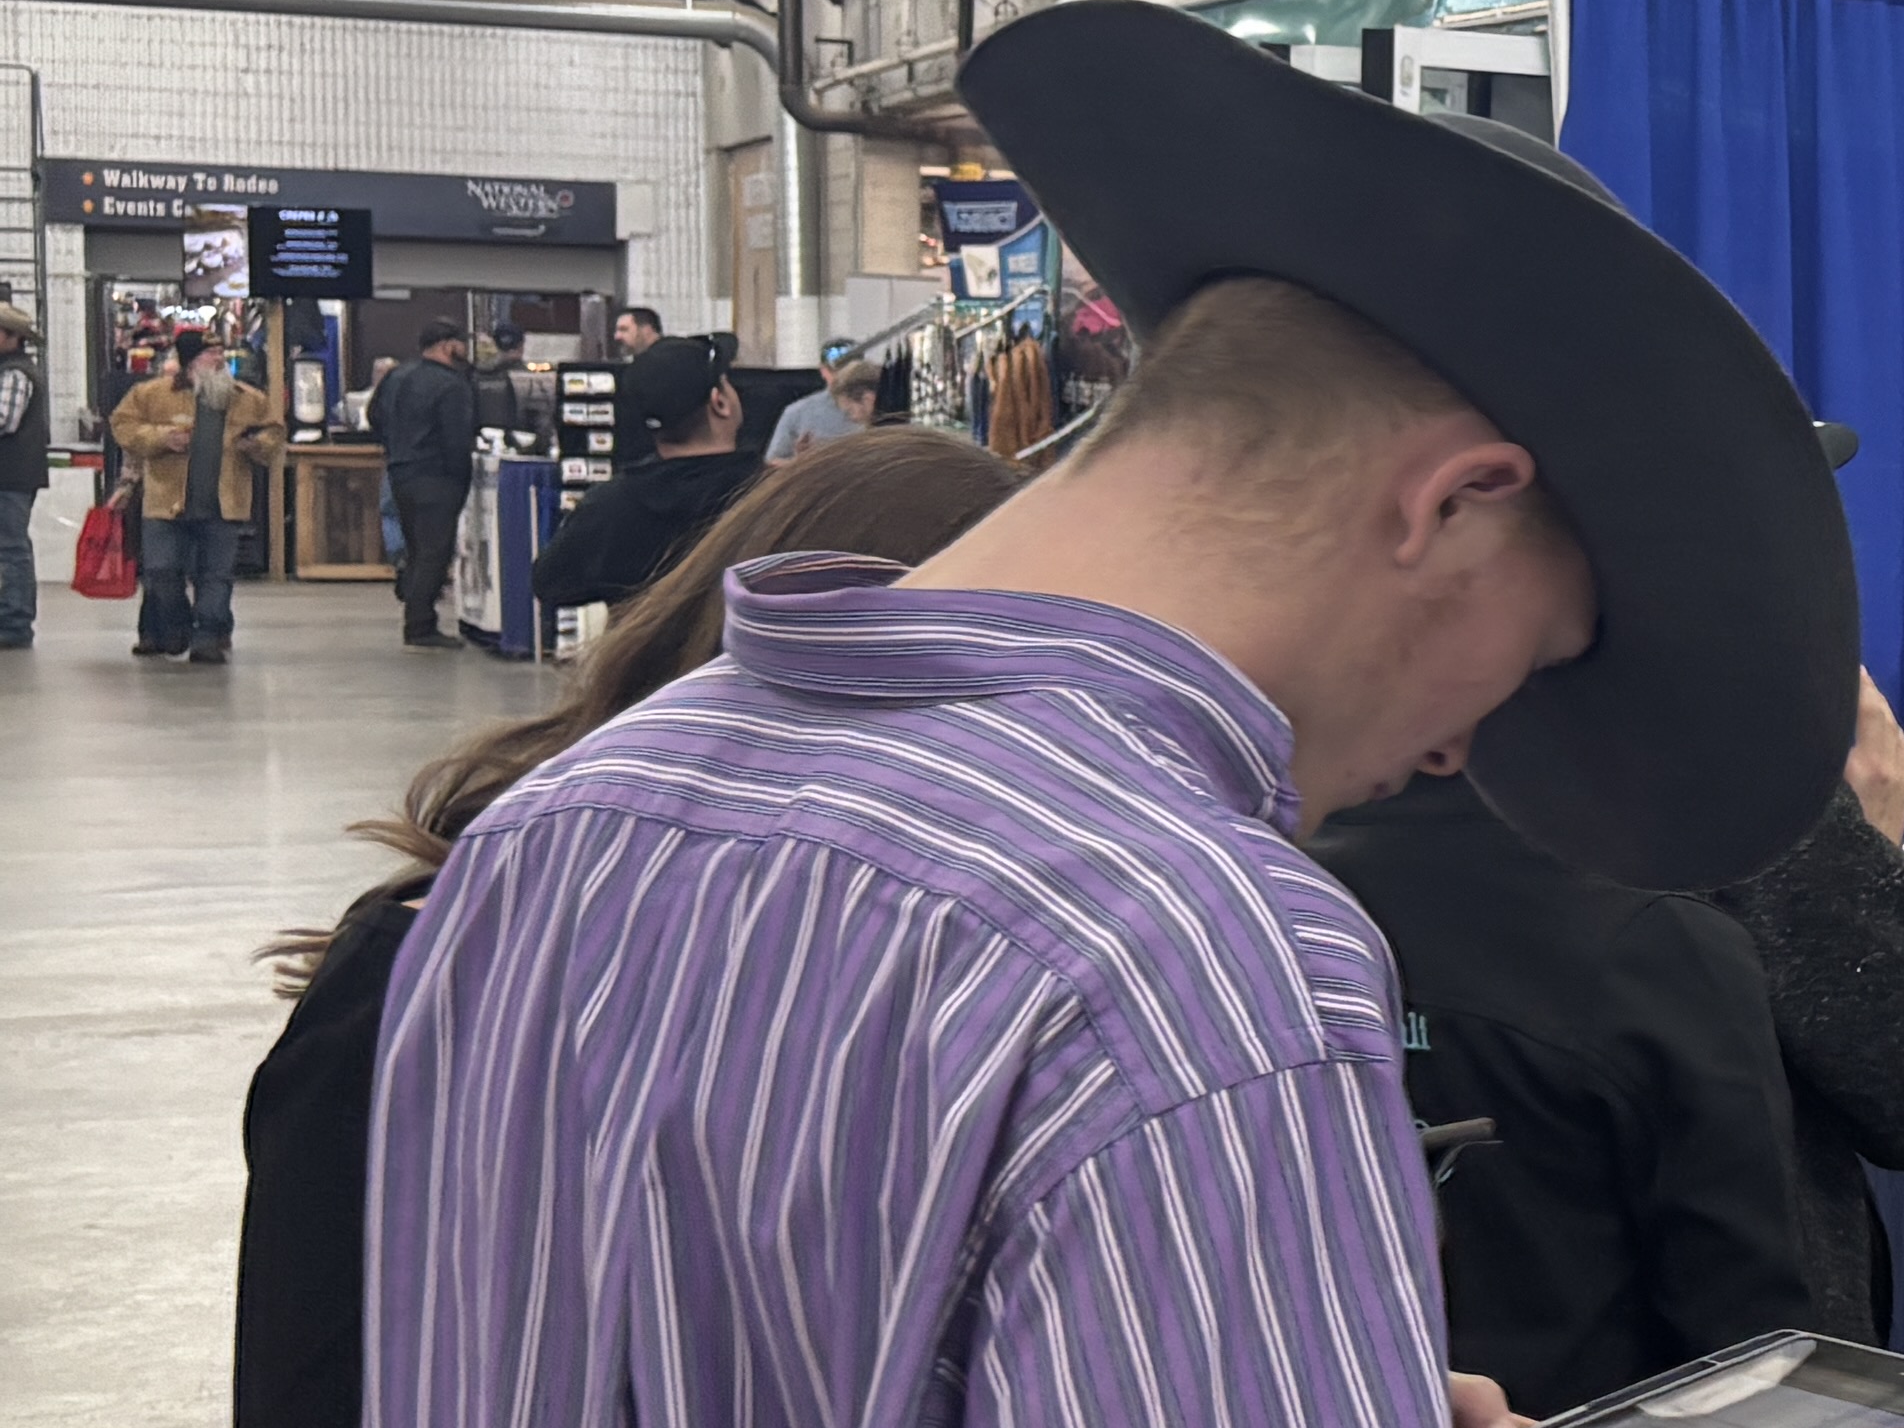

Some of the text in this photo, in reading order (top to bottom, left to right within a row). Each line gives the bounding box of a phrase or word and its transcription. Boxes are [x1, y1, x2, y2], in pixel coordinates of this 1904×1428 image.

[103, 168, 280, 195] Walkway To Rodeo
[103, 196, 166, 218] Events
